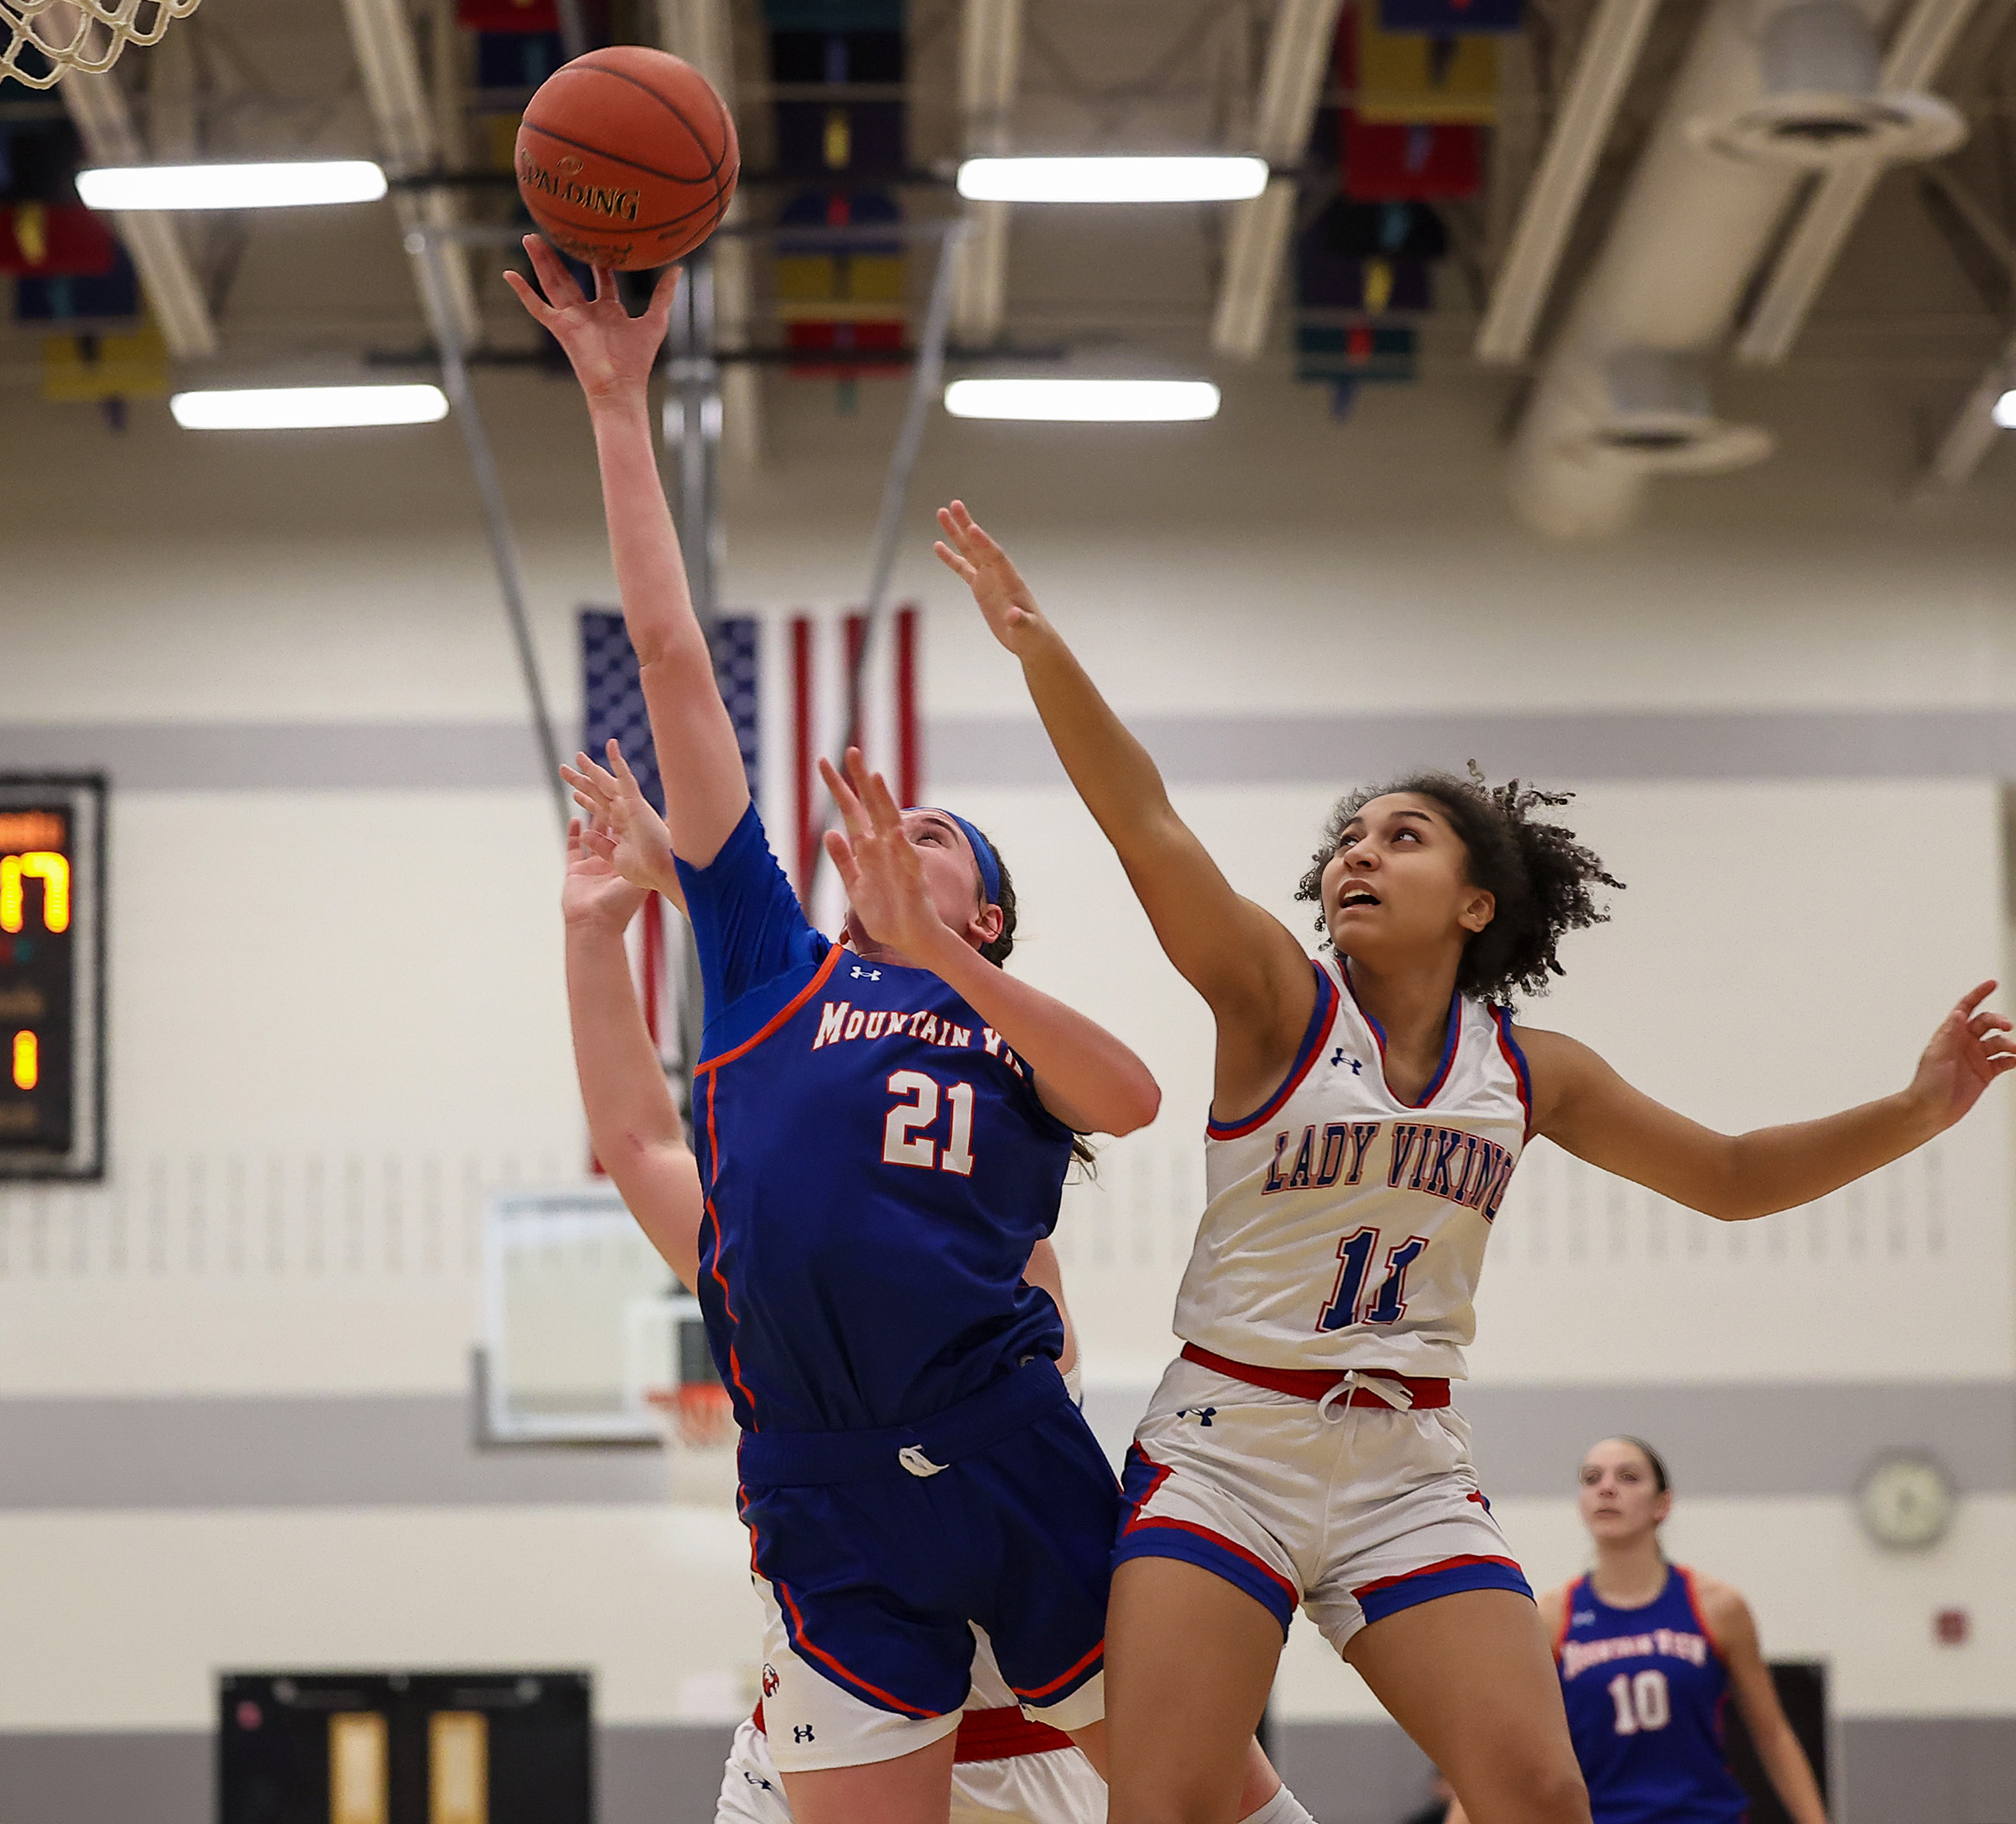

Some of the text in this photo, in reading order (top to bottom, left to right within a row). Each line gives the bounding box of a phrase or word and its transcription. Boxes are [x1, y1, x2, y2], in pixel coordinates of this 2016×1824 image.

[811, 1001, 972, 1052] MOUNTAIN
[881, 1068, 975, 1178] 21
[1262, 1122, 1381, 1195] LADY
[1314, 1226, 1429, 1332] 11
[1608, 1669, 1670, 1735] 10
